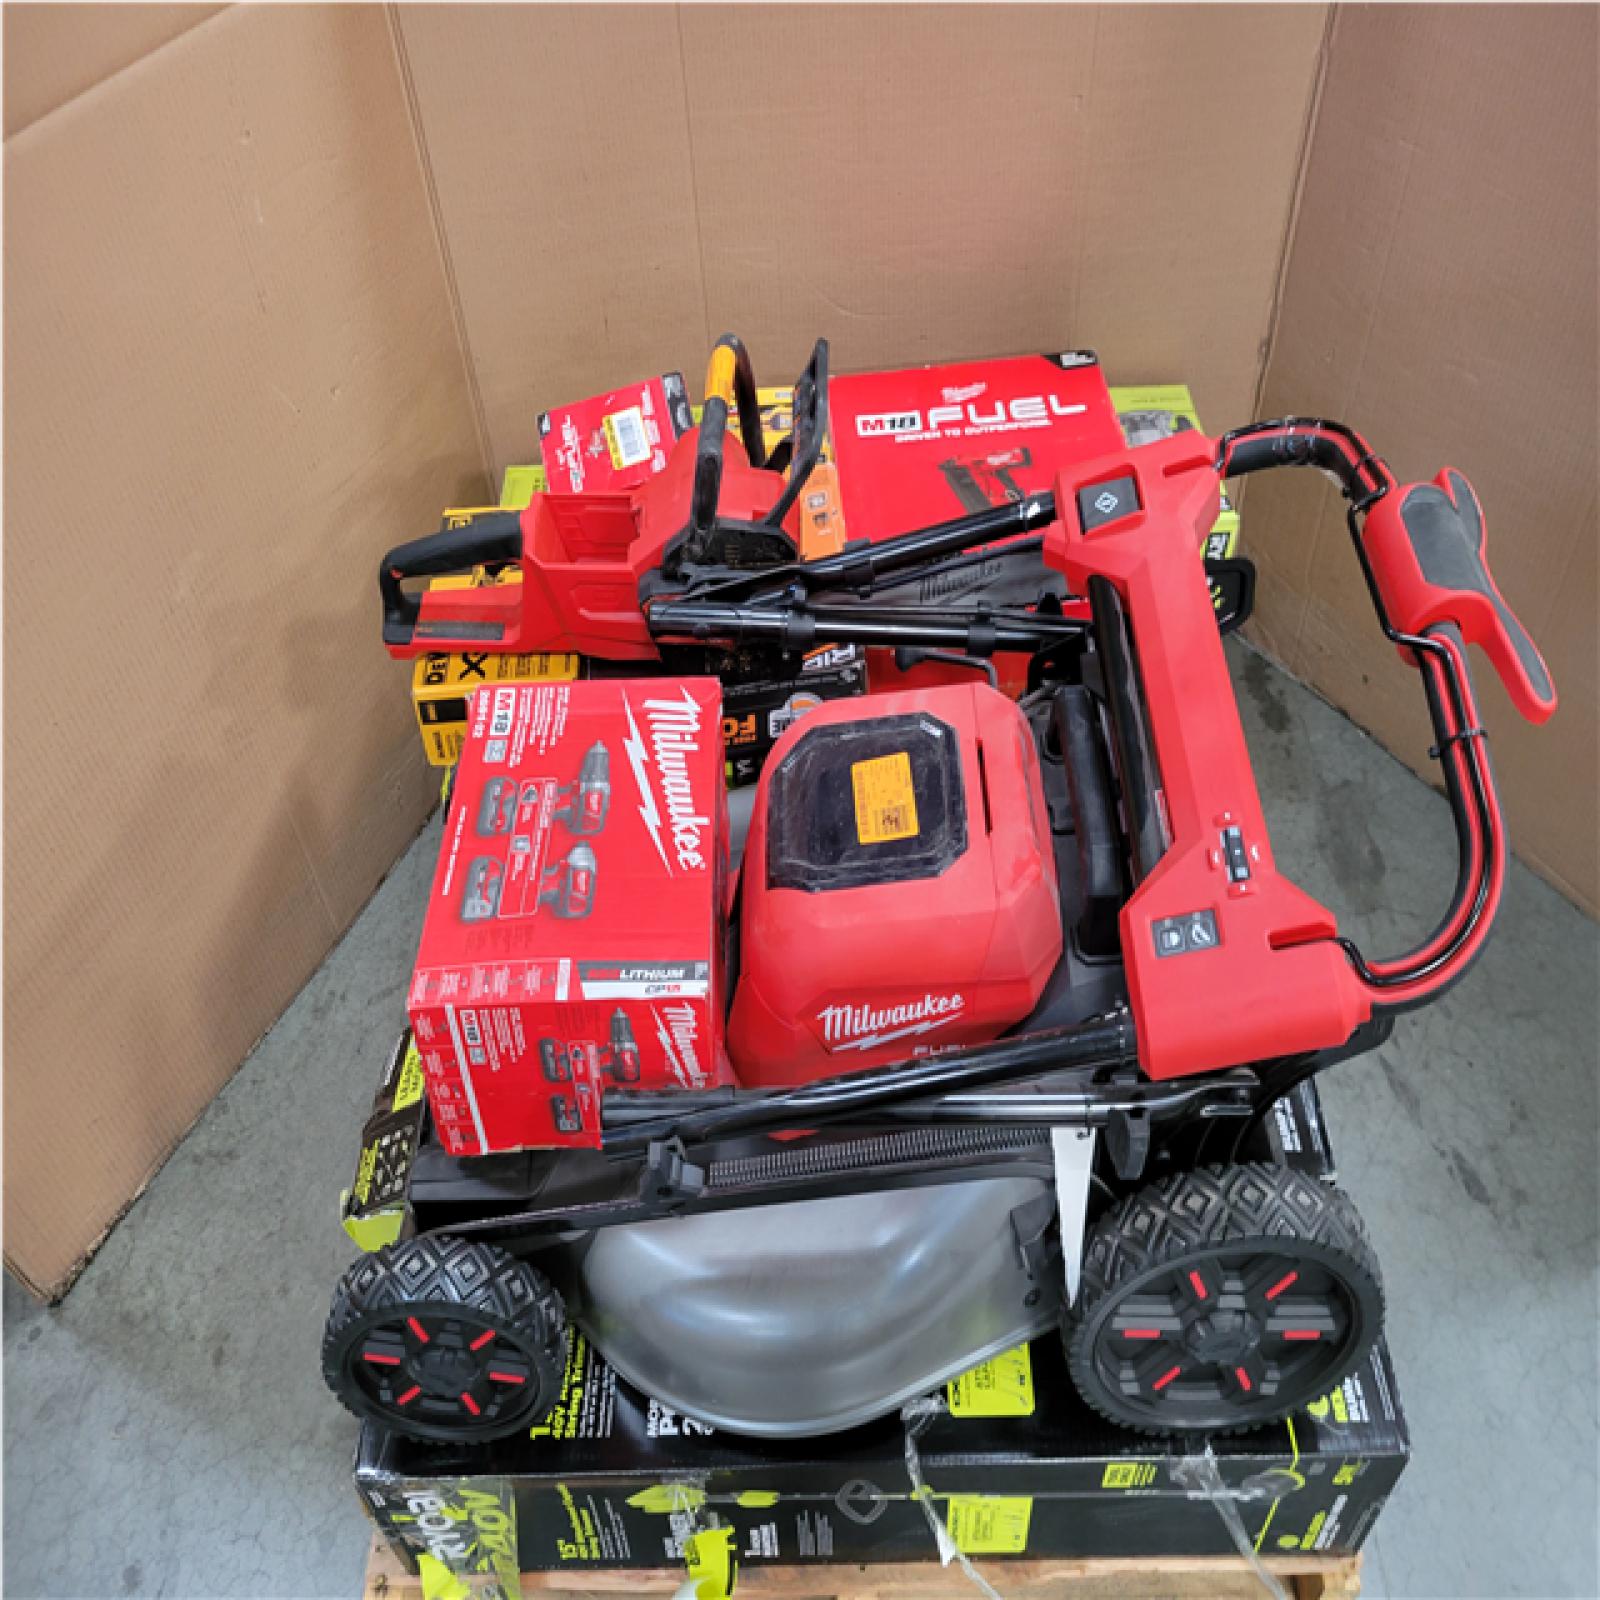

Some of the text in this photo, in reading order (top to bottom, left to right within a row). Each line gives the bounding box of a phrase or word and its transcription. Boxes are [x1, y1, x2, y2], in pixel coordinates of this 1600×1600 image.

[858, 394, 1087, 435] M18 FUEL
[491, 690, 514, 734] M18
[642, 685, 710, 871] Milwaukee
[619, 968, 685, 981] LITHIUM
[815, 992, 965, 1041] Milwaukee
